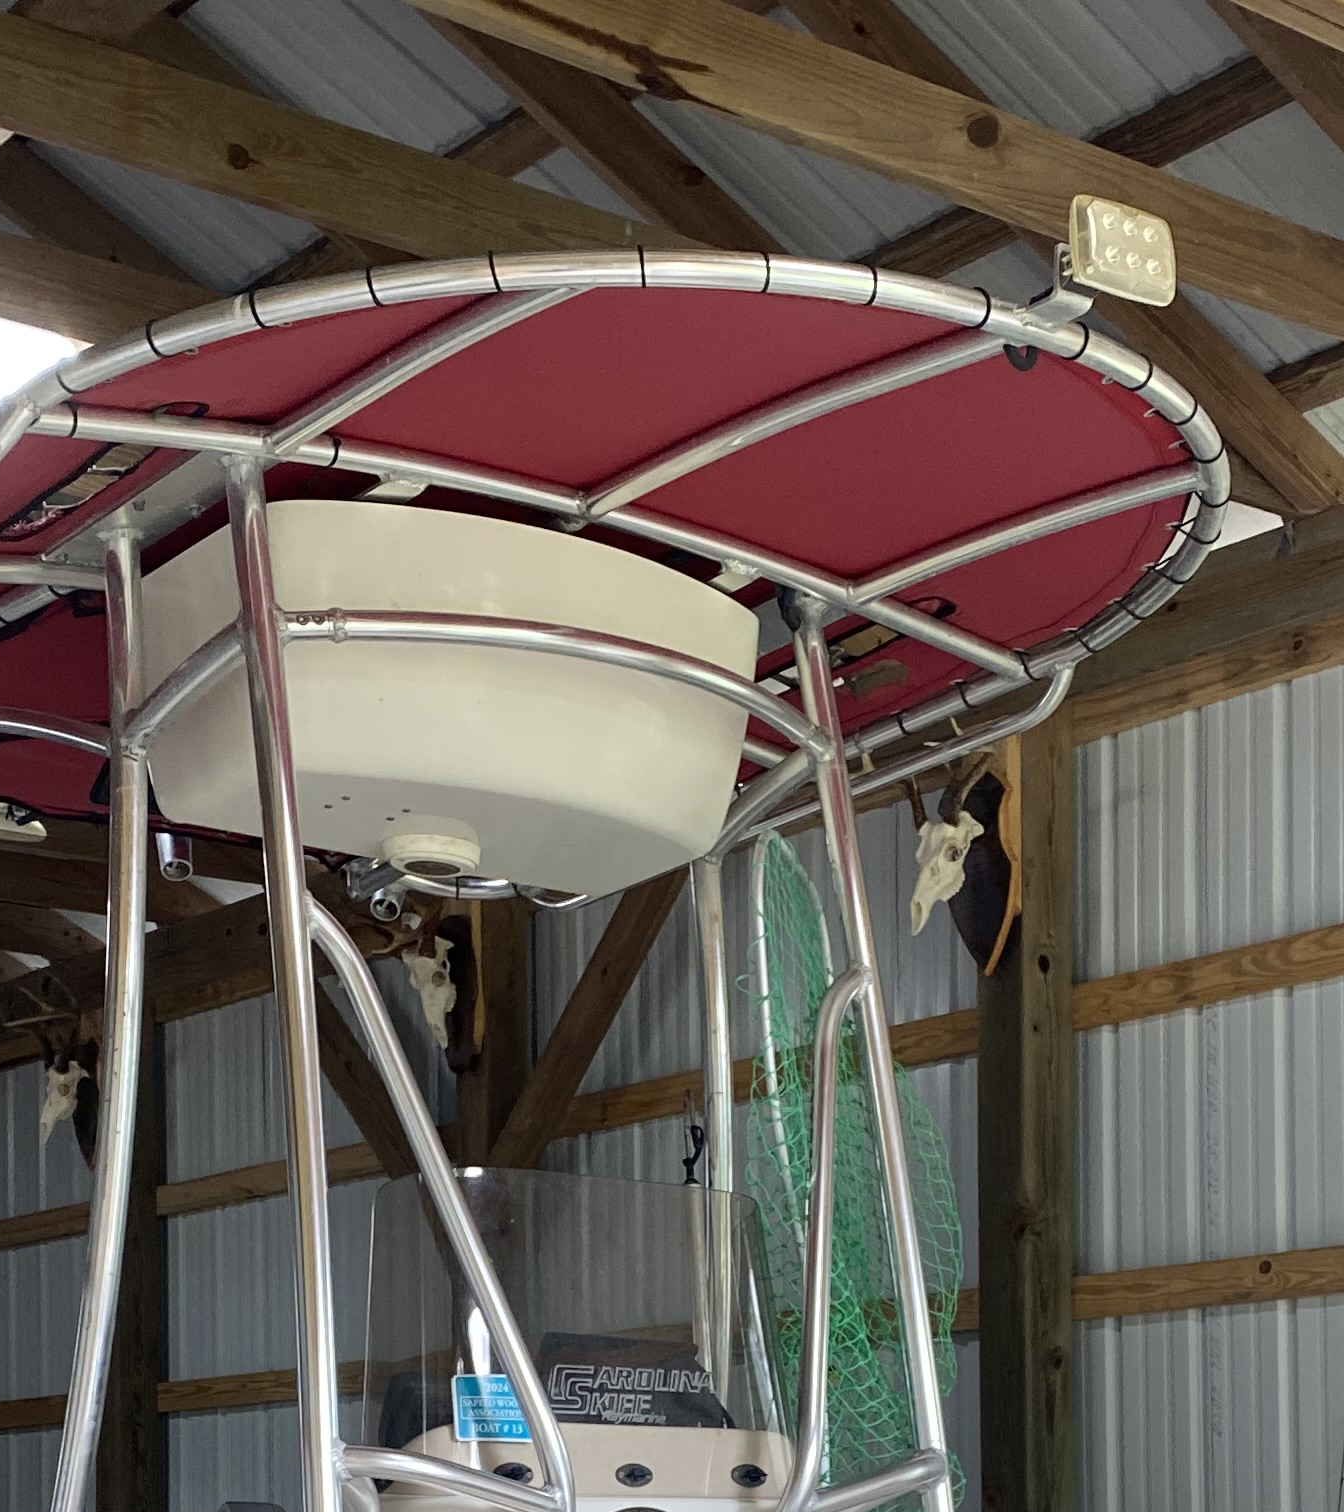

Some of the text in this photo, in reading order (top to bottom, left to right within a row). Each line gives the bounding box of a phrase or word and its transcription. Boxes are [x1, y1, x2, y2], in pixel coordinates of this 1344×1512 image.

[485, 1382, 510, 1393] 2024
[472, 1422, 501, 1433] BOAT
[512, 1424, 523, 1435] 13
